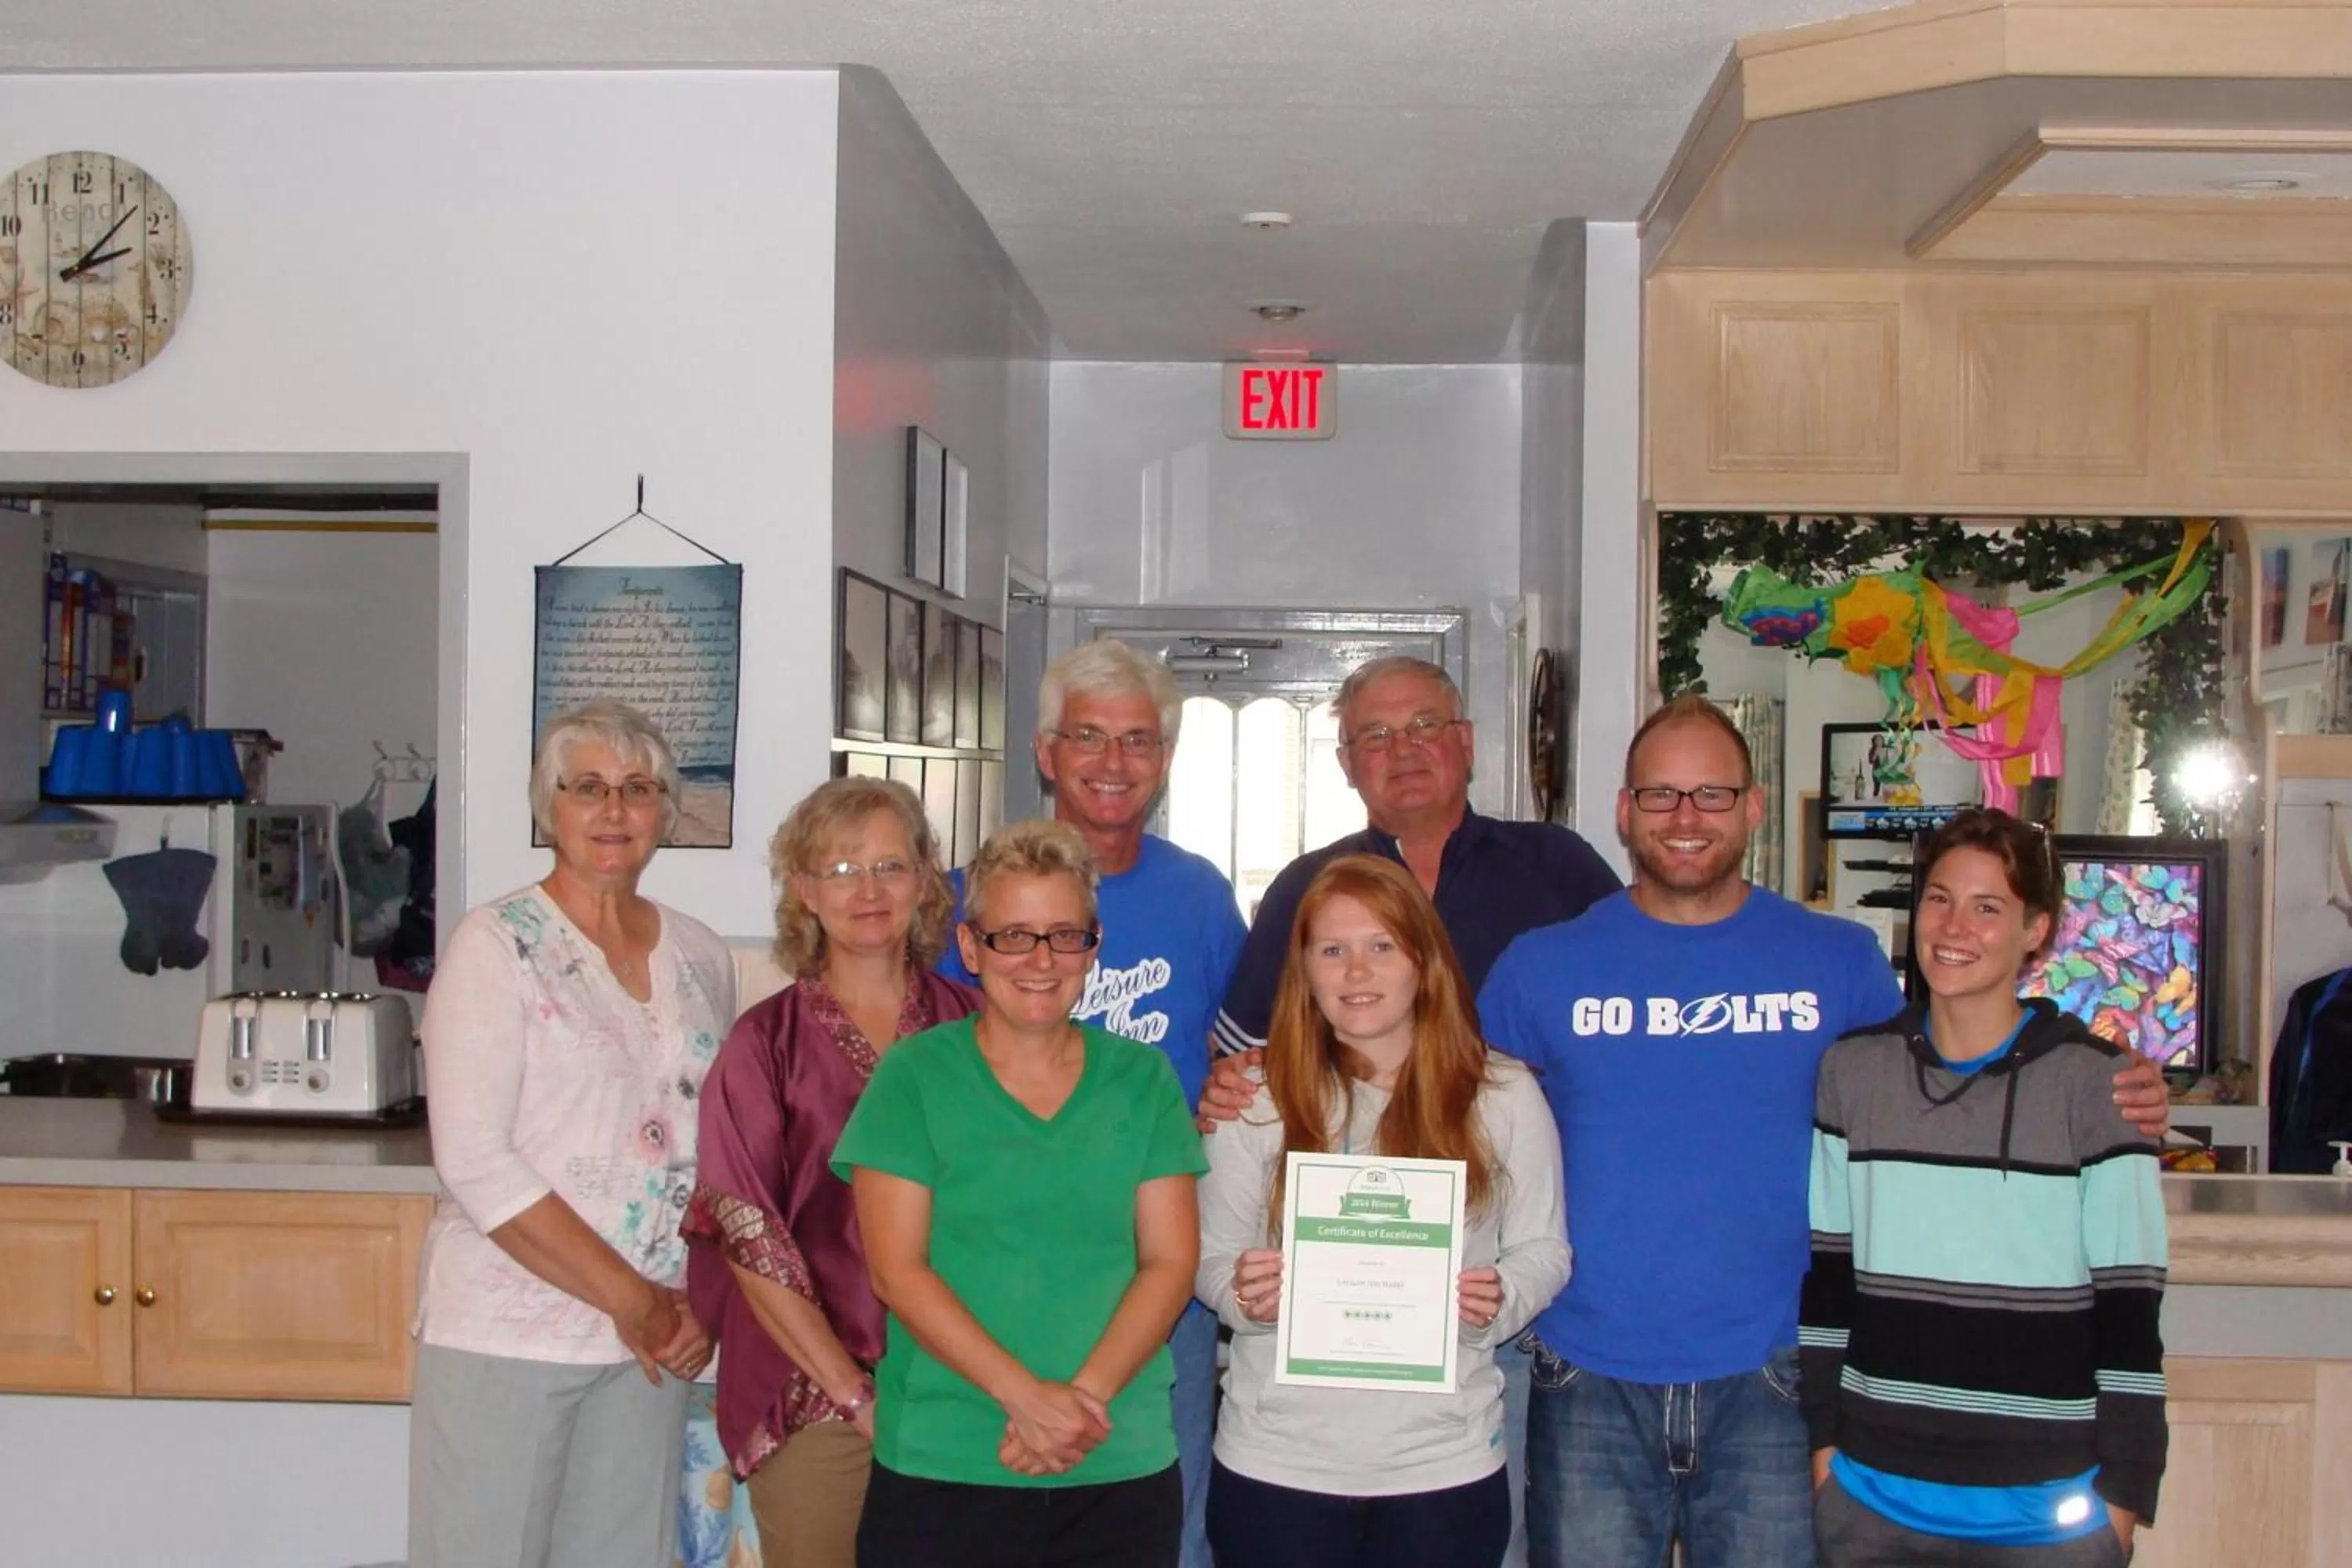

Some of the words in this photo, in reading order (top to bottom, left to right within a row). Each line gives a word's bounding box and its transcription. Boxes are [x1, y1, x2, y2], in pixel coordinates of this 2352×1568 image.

[73, 171, 93, 194] 12
[32, 183, 49, 205] 11
[119, 183, 125, 205] 1
[1, 215, 22, 237] 10
[147, 212, 160, 235] 2
[144, 302, 158, 324] 4
[1241, 368, 1324, 430] EXIT
[1572, 996, 1634, 1036] GO
[1646, 991, 1820, 1039] BOLTS
[1317, 1225, 1367, 1239] Certificate
[1368, 1228, 1378, 1239] of
[1379, 1229, 1429, 1241] Excellence
